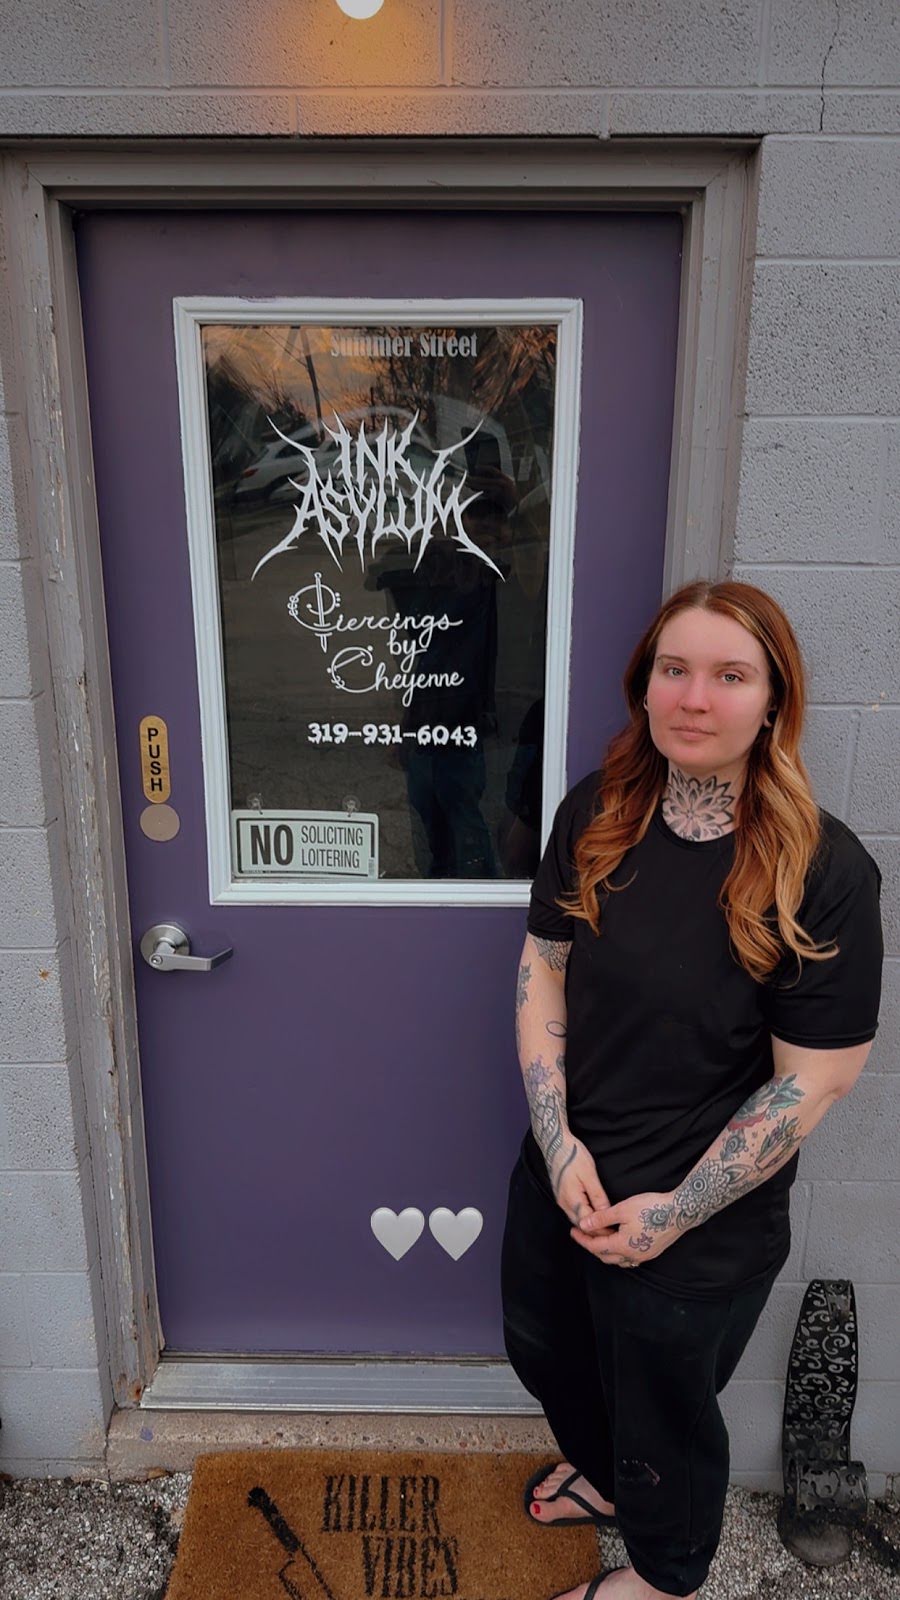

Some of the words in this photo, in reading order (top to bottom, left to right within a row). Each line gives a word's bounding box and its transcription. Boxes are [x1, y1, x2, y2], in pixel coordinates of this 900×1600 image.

[331, 332, 413, 358] Summer
[419, 332, 478, 358] Street
[320, 408, 425, 498] INK
[251, 415, 506, 582] ASYLUM
[287, 572, 463, 653] Piercings
[327, 645, 465, 708] Cheyenne
[387, 628, 428, 673] by
[146, 727, 163, 792] PUSH
[307, 722, 478, 748] 319-931-6043
[250, 824, 294, 867] NO
[301, 825, 364, 846] SOLICITING
[301, 848, 361, 869] LOITERING
[321, 1473, 441, 1534] KILLER
[362, 1535, 459, 1598] VIBES
